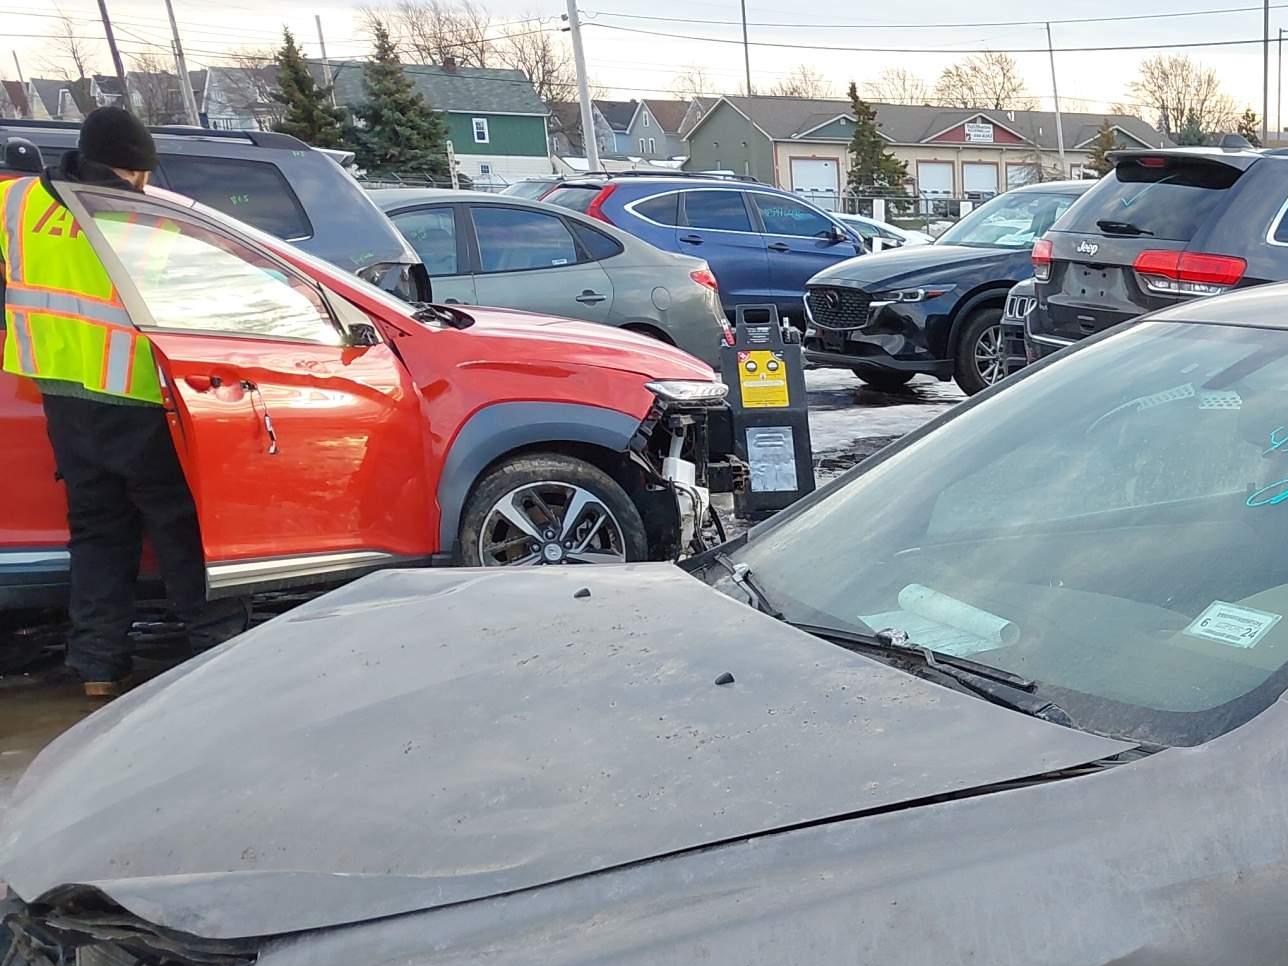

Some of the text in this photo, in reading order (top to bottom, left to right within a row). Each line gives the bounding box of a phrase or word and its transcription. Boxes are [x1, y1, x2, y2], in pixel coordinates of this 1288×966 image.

[1076, 240, 1099, 257] Jeep
[1200, 617, 1212, 628] 6
[1240, 627, 1260, 640] 24
